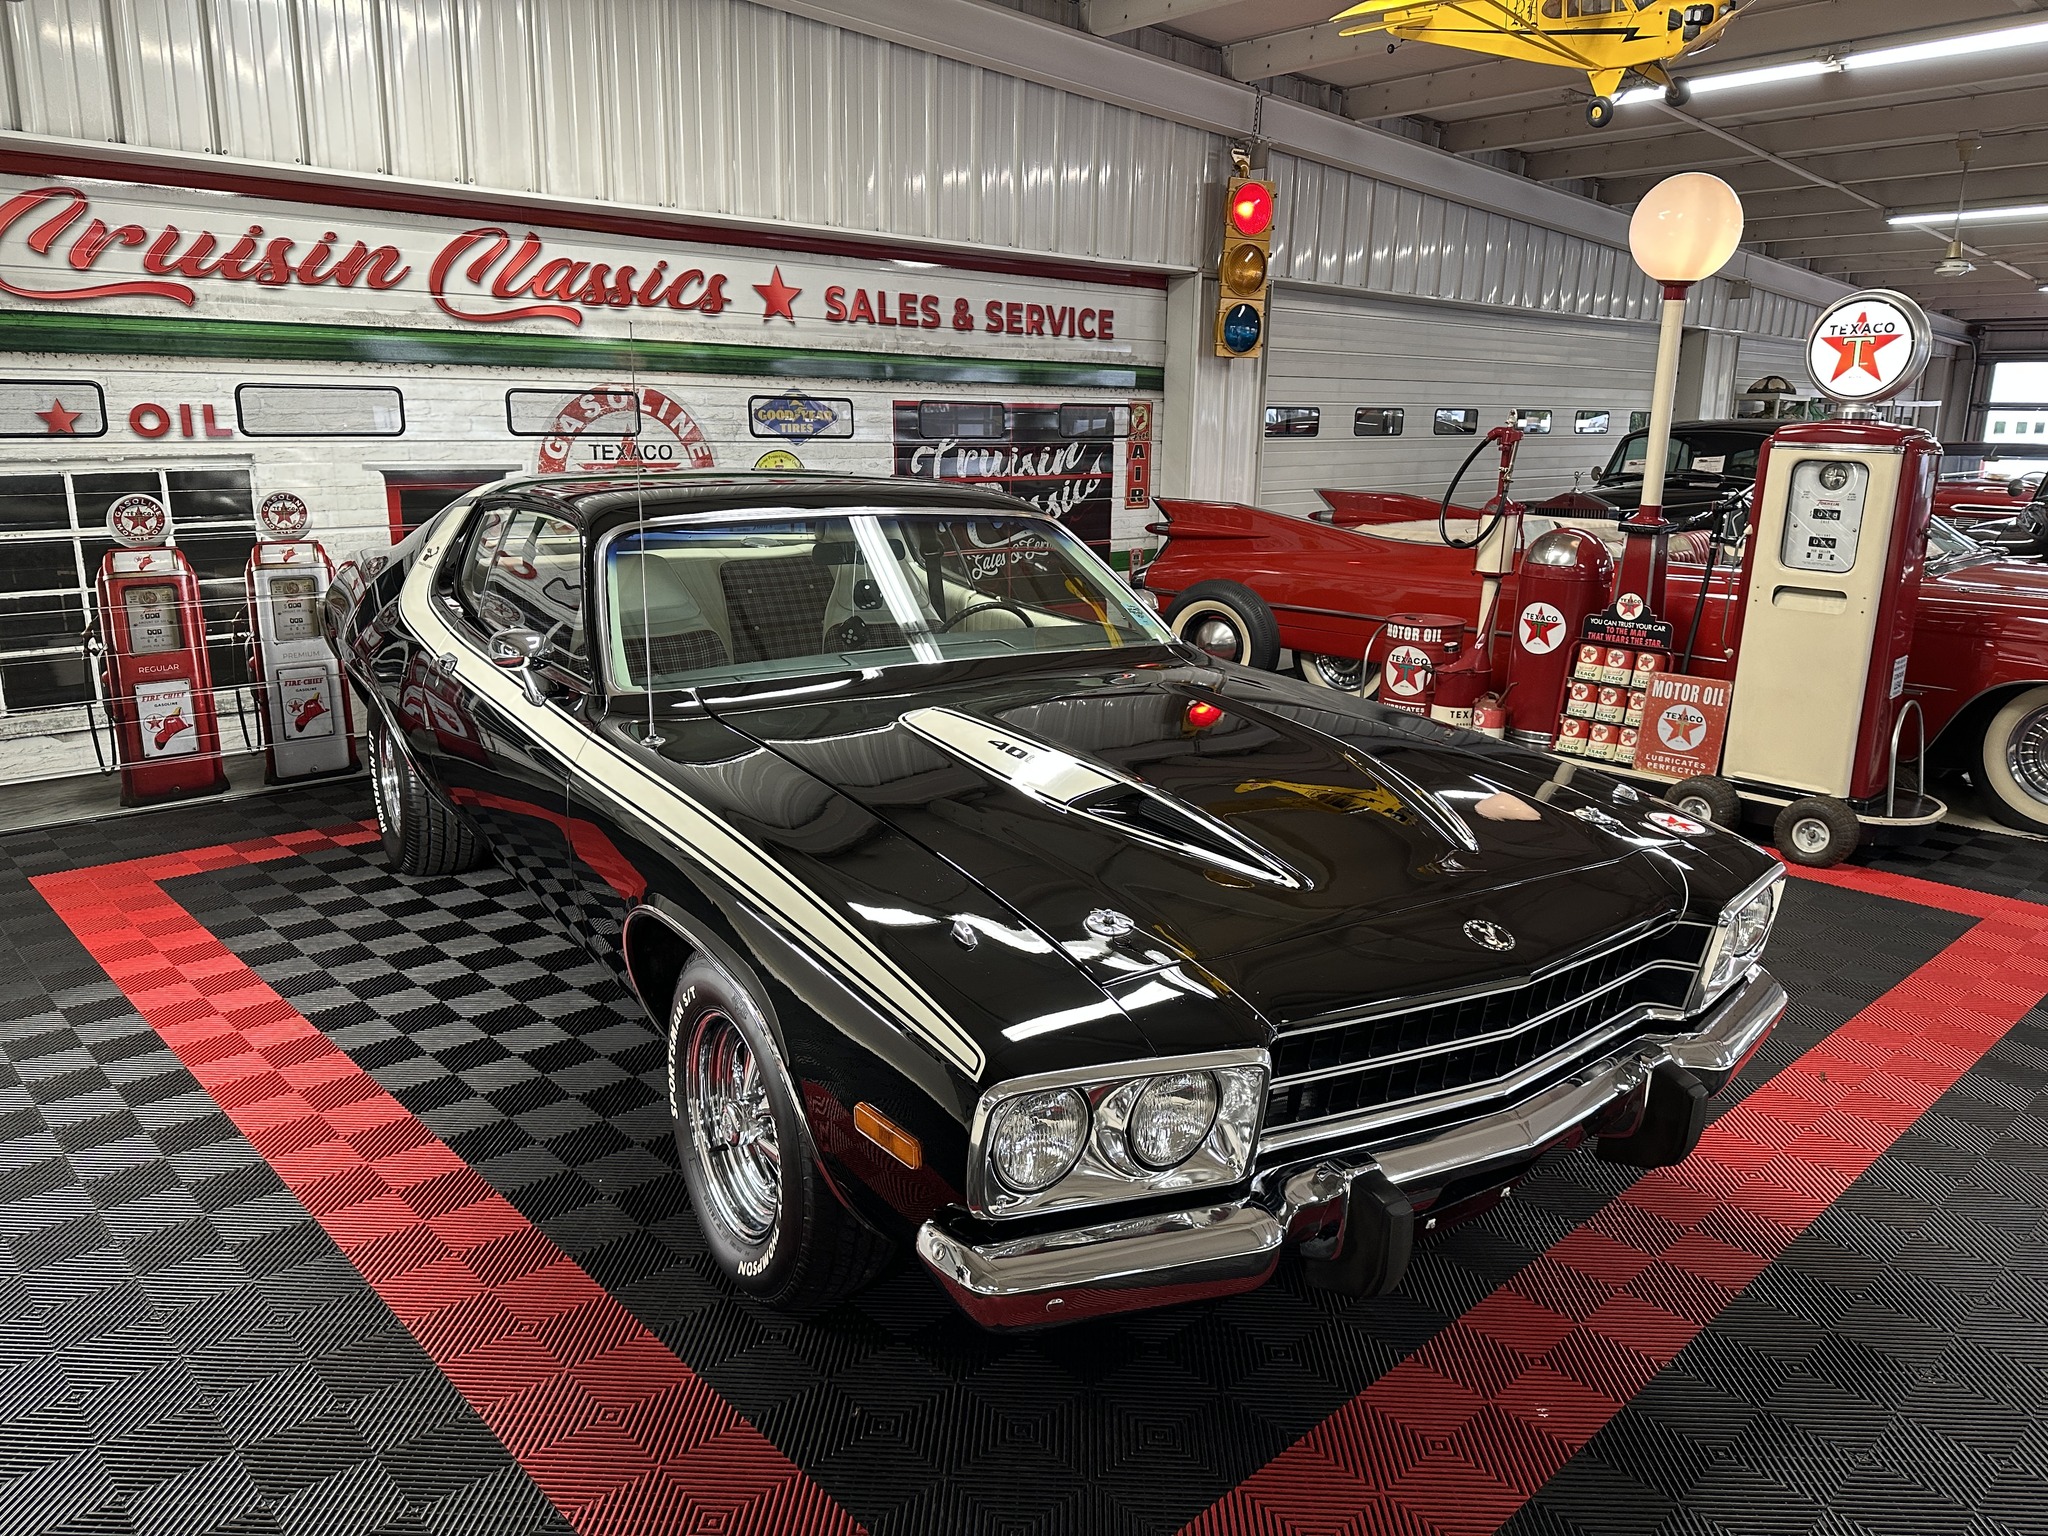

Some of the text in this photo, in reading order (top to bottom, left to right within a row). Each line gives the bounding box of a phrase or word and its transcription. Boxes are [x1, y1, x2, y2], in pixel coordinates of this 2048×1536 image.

[0, 186, 731, 326] Cruisin Classics
[825, 285, 1115, 340] SALES & SERVICE
[1830, 322, 1895, 335] TEXACO
[129, 403, 233, 438] OIL
[545, 385, 711, 460] GASOLINE
[780, 423, 814, 433] TIRES
[588, 444, 673, 461] TEXACO
[1131, 444, 1145, 503] AIR
[115, 498, 162, 517] GASOLINE
[263, 494, 305, 512] GASOLINE
[967, 553, 1006, 580] Sales
[1526, 612, 1558, 622] TEXACO
[1603, 619, 1617, 627] CAN
[1618, 621, 1635, 629] TRUST
[1635, 622, 1652, 631] YOUR
[1653, 624, 1666, 632] CAR
[1387, 623, 1442, 642] MOTOR OIL
[1587, 631, 1604, 640] THAT
[1604, 634, 1629, 644] WEARS
[1630, 636, 1643, 645] THE
[1606, 626, 1647, 637] TO THE MAN
[282, 650, 320, 659] PREMIUM
[1391, 654, 1428, 666] TEXACO
[138, 663, 180, 674] REGULAR
[285, 677, 323, 687] FIRE-CHIEF
[141, 691, 186, 702] FIRE-CHIEF
[1651, 680, 1724, 707] MOTOR OIL
[1450, 711, 1473, 719] TEX
[1666, 711, 1703, 723] TEXACO
[1646, 753, 1706, 770] LUBRICATES
[1647, 761, 1702, 776] PERFECTLY
[369, 756, 388, 834] SPORTSMAN
[668, 985, 696, 1119] SPORTSMAN S/T
[737, 1224, 780, 1276] THOMPSON
